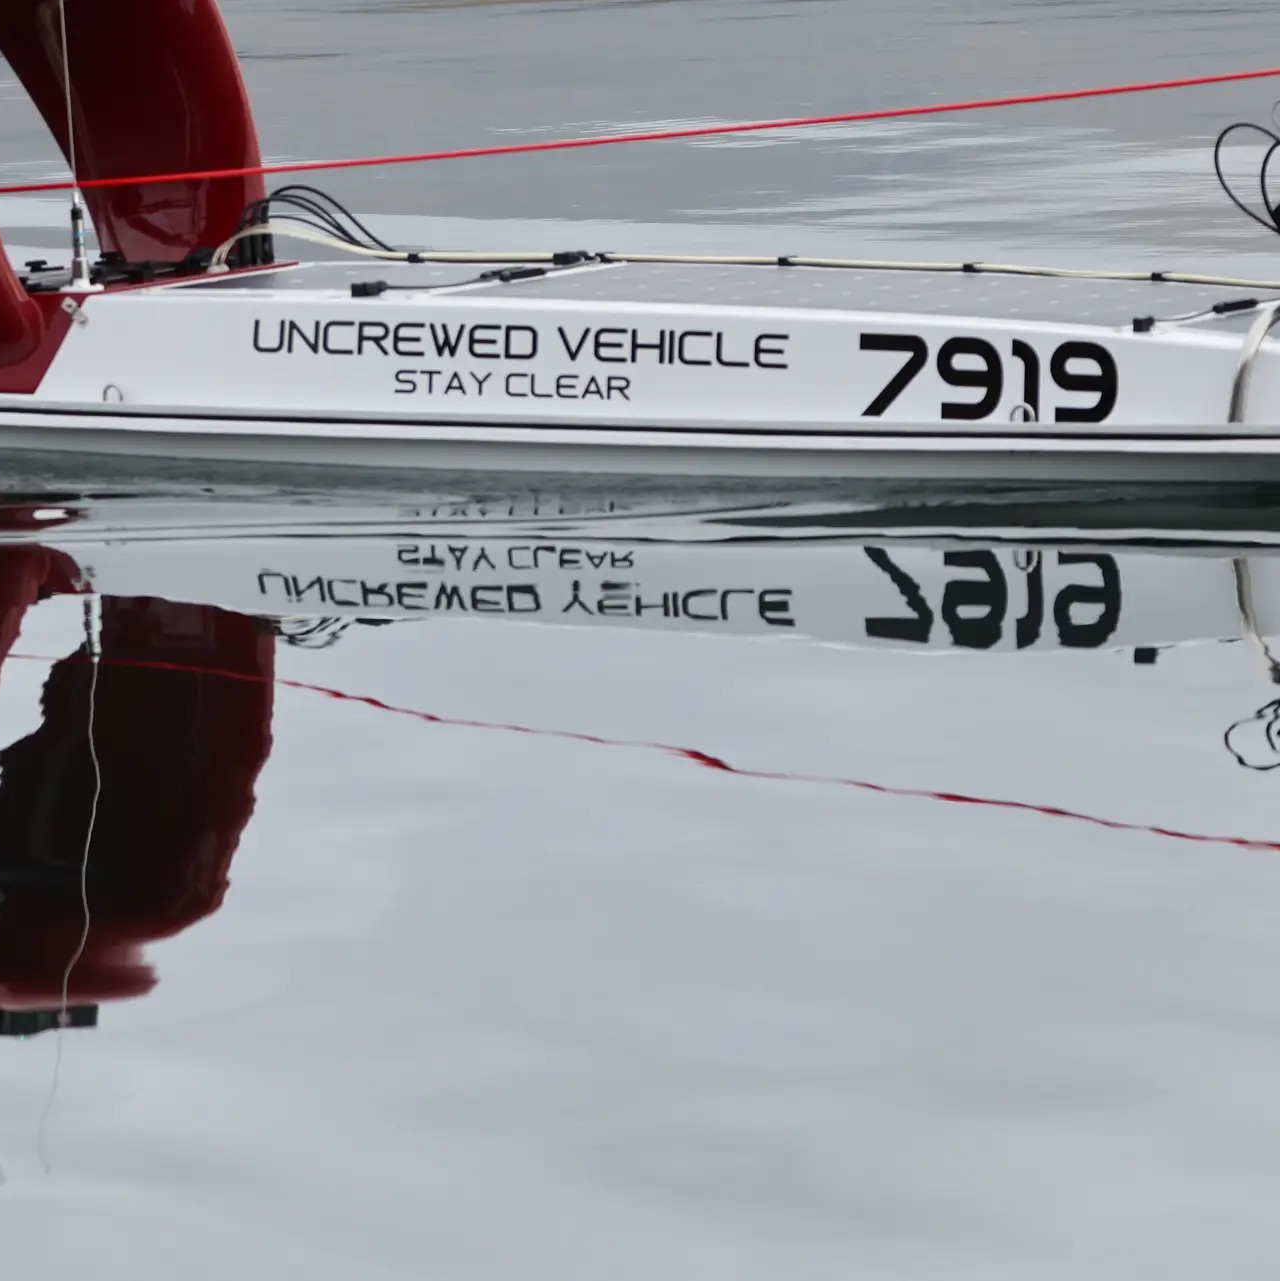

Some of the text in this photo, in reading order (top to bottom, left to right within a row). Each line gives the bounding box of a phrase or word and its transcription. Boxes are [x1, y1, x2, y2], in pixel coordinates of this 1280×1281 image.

[253, 319, 791, 370] UNCREWED VEHICLE
[394, 369, 631, 401] STAY CLEAR
[859, 332, 1119, 423] 7919
